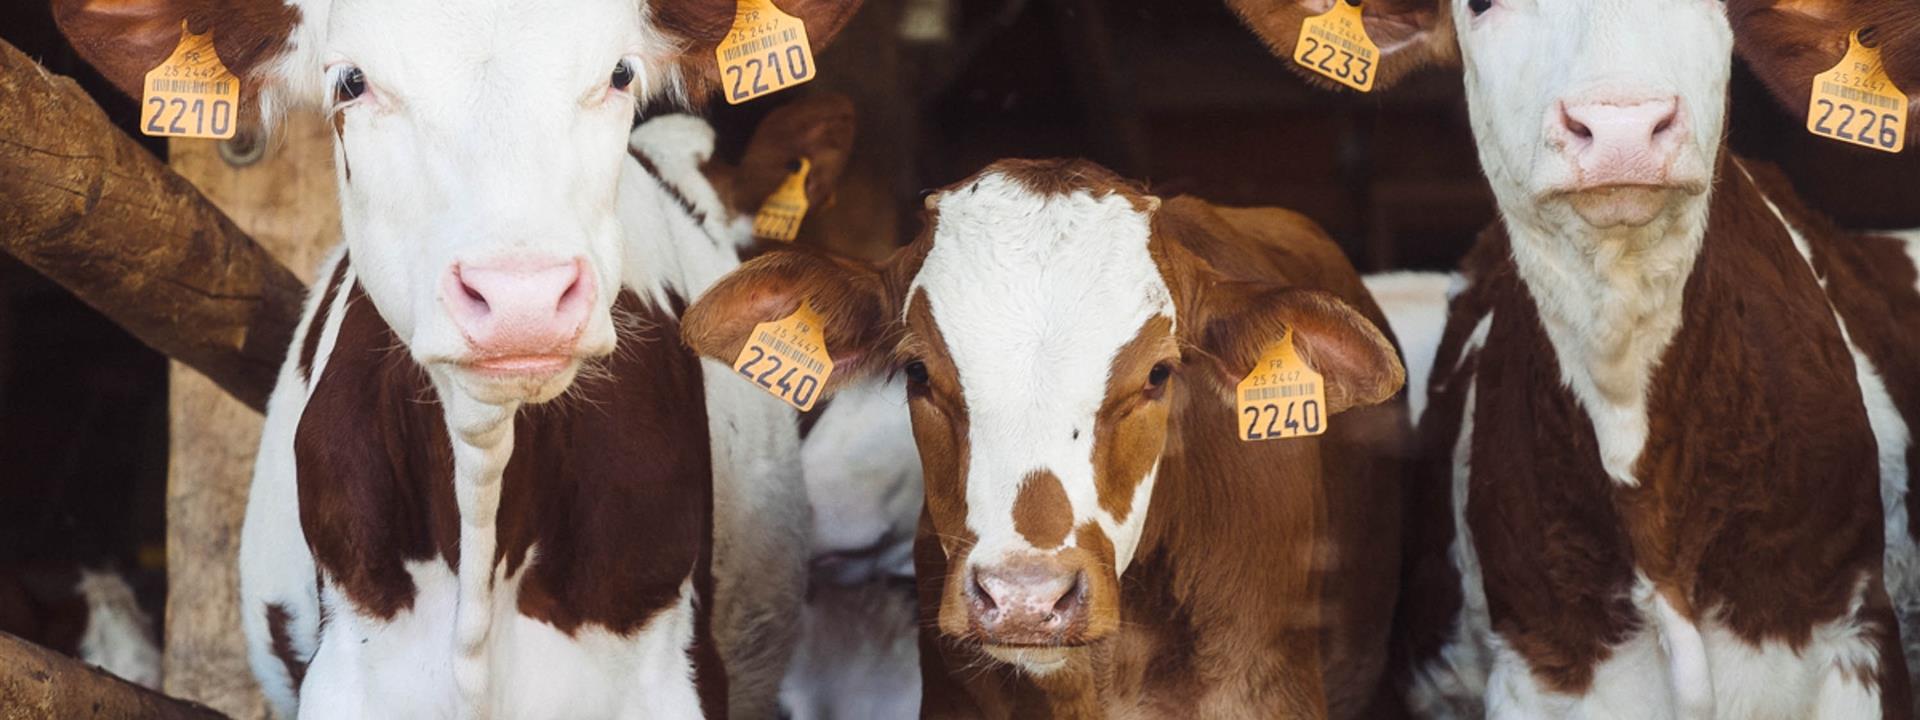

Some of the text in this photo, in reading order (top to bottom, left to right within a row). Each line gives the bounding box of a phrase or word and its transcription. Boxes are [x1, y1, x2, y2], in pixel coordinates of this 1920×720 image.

[745, 10, 760, 23] FR
[184, 52, 200, 63] FR
[726, 45, 807, 100] 2210
[1301, 37, 1371, 85] 2233
[1854, 62, 1869, 74] FR
[147, 96, 231, 135] 2210
[1815, 99, 1899, 149] 2226
[739, 345, 818, 407] 2240
[1253, 374, 1266, 386] 25
[1270, 359, 1283, 370] FR
[1244, 399, 1320, 439] 2240
